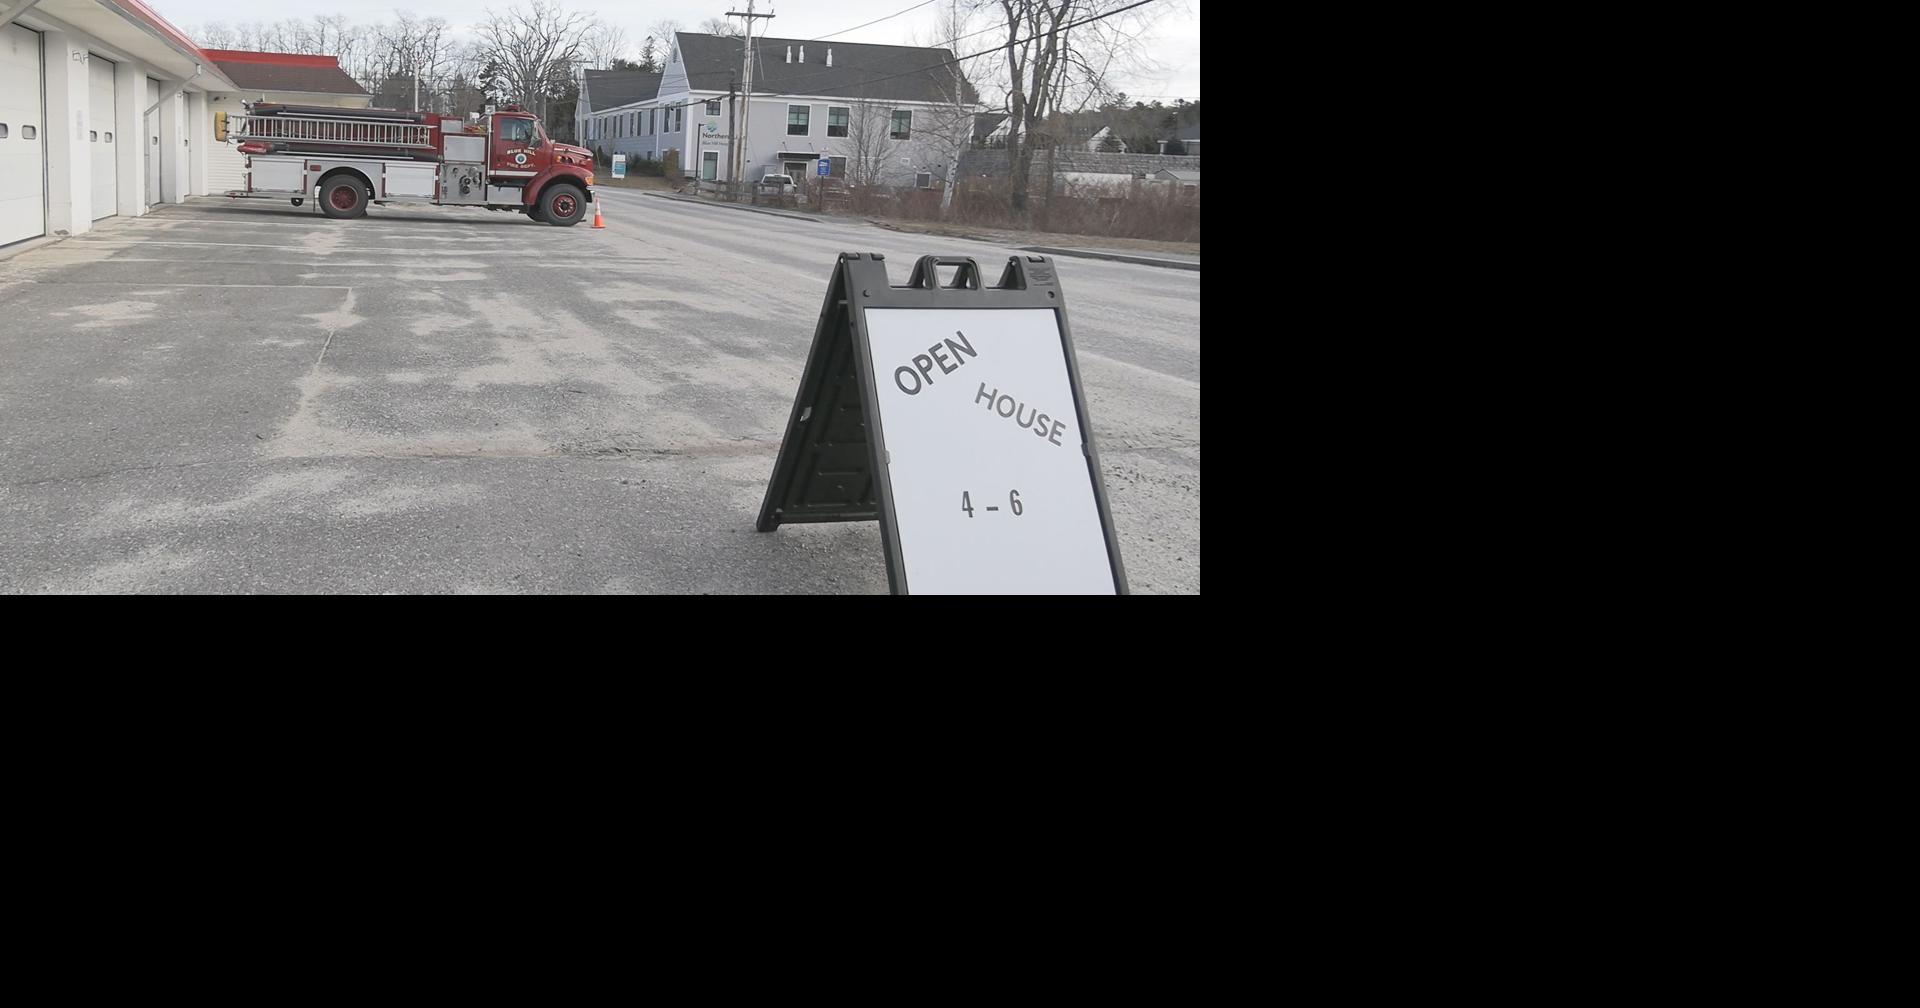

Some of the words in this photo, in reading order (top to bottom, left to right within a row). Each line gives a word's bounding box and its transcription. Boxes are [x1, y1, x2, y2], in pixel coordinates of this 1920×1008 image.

[894, 330, 978, 396] OPEN
[974, 382, 1066, 447] HOUSE
[961, 490, 974, 519] 4
[1009, 489, 1023, 517] 6
